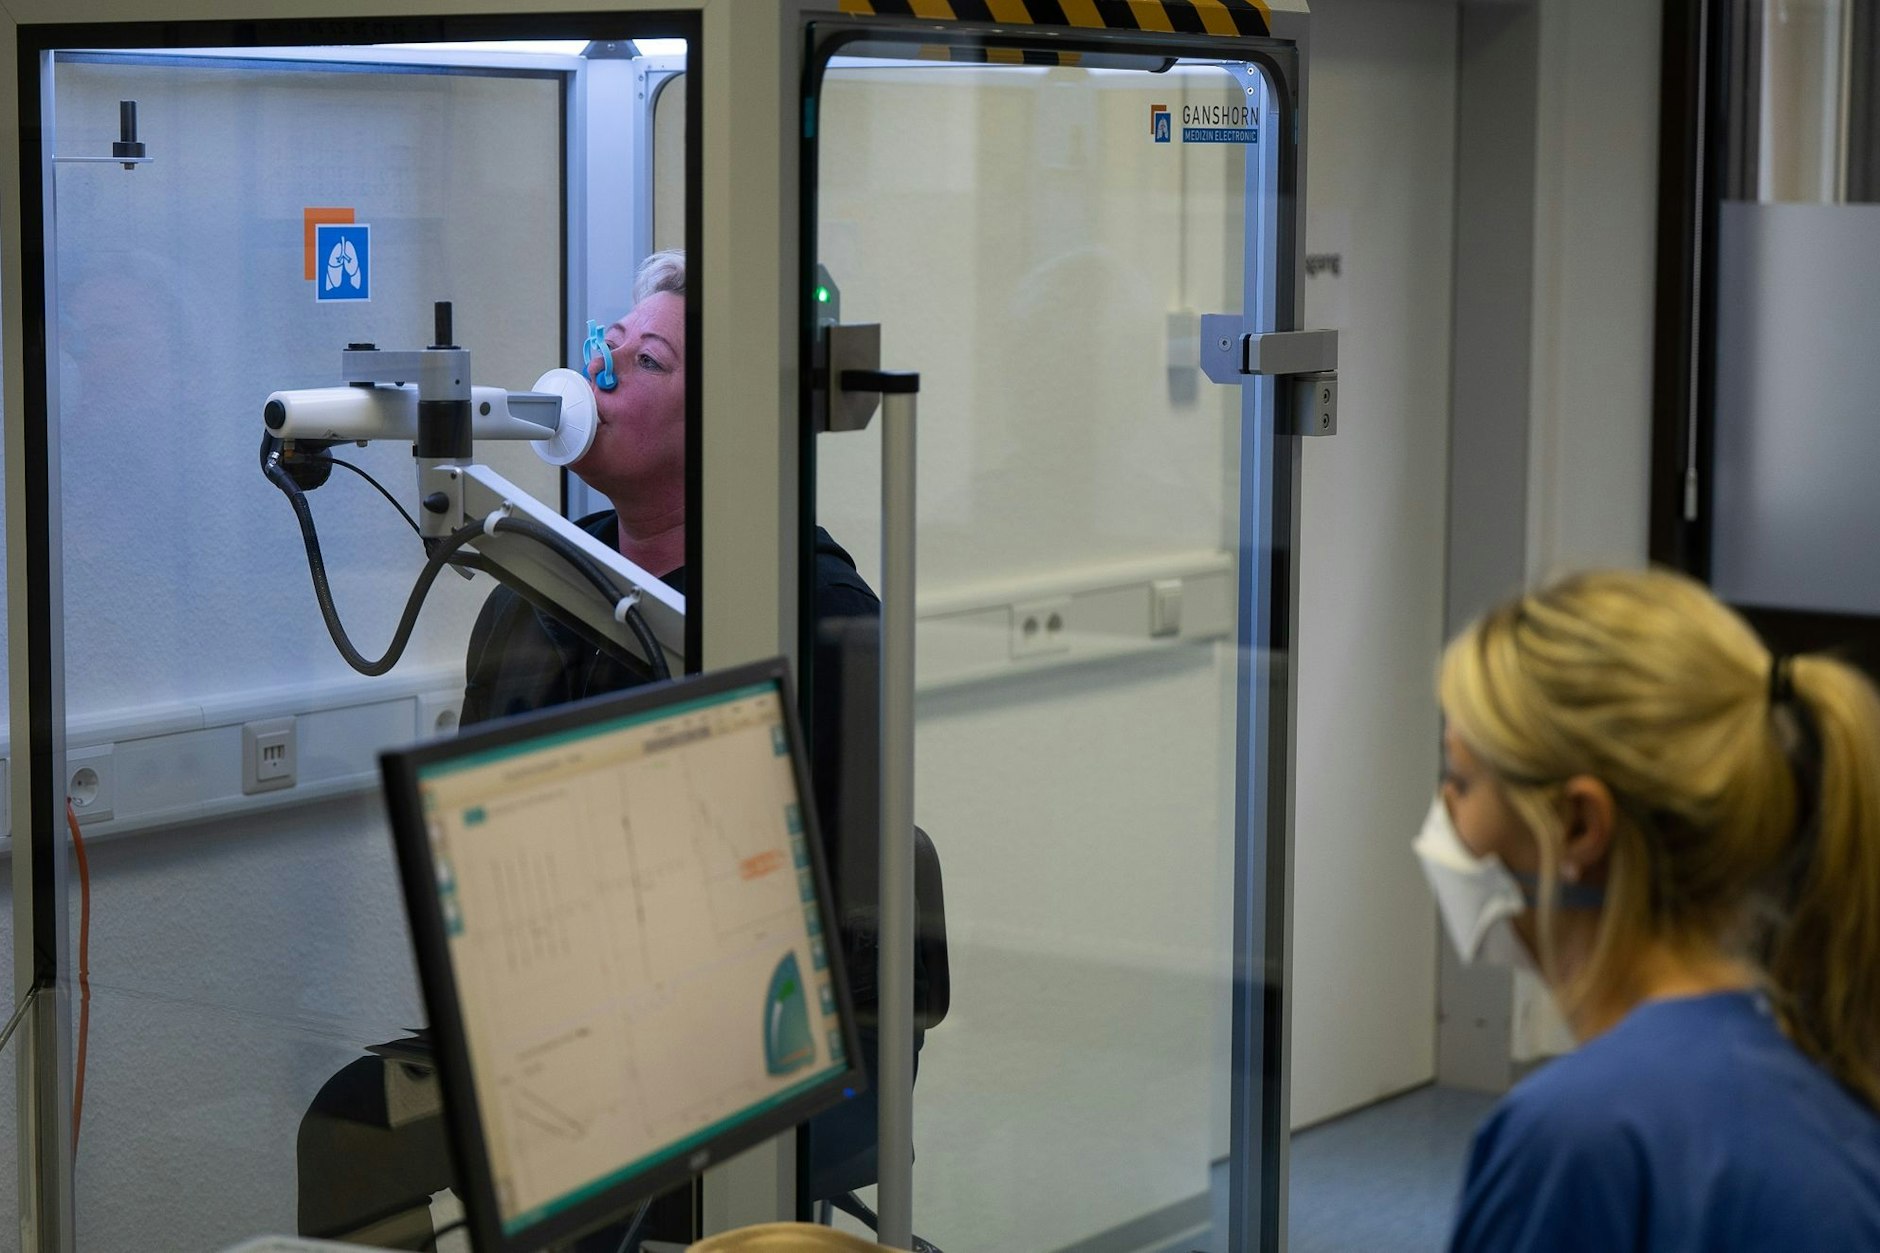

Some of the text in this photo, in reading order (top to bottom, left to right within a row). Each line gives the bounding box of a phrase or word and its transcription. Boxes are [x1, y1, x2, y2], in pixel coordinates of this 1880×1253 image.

[1183, 105, 1259, 126] GANSHORN
[1185, 129, 1257, 141] MEDIZIN ELECTRONIC
